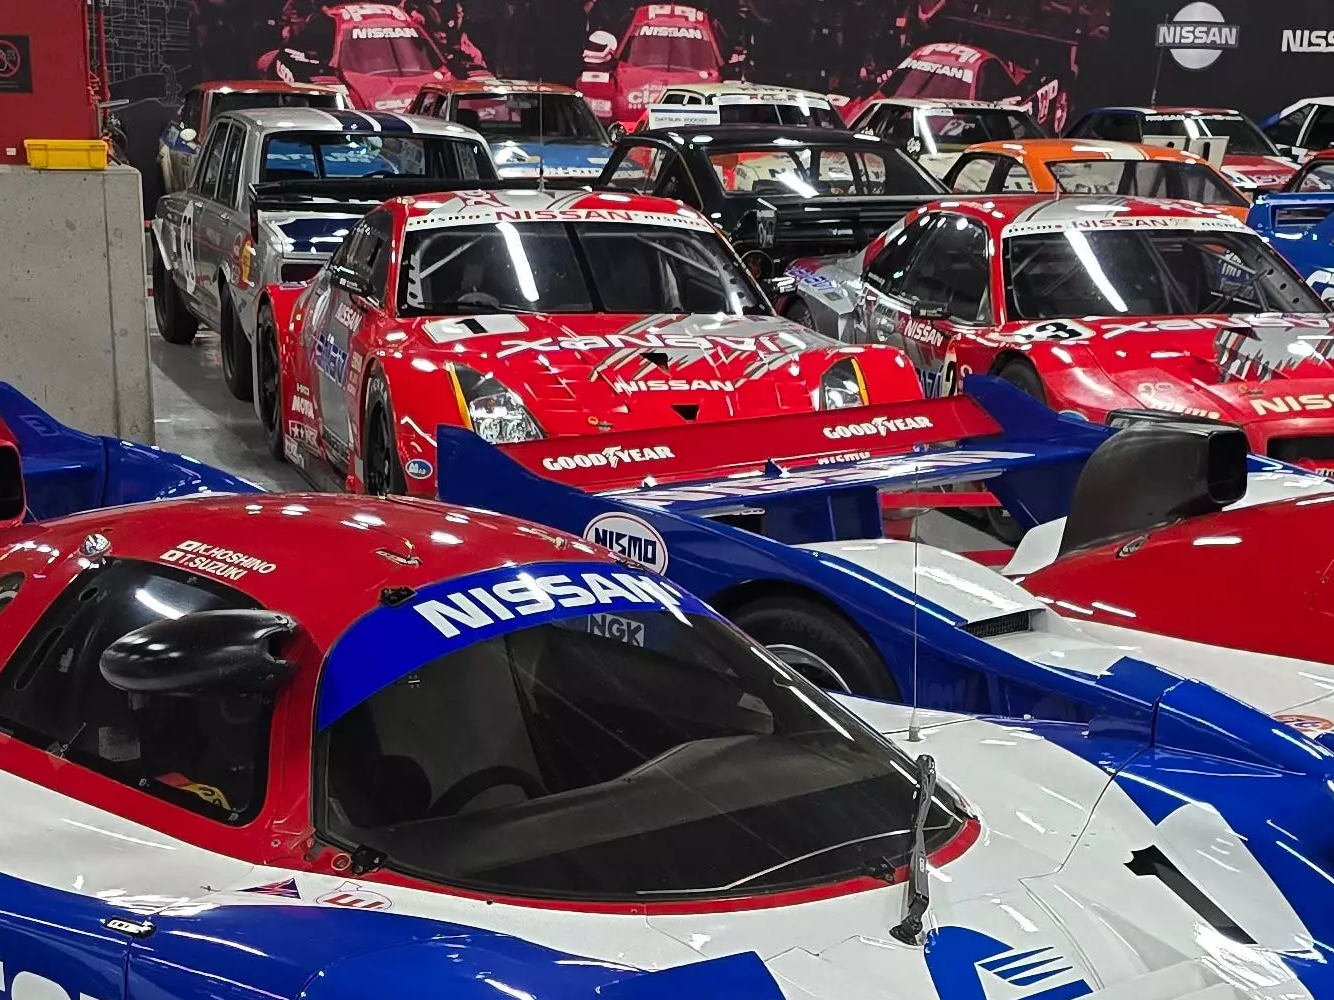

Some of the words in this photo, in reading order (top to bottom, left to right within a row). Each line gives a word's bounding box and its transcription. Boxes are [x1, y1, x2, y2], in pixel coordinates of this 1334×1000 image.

[1158, 26, 1237, 45] NISSAN
[495, 210, 633, 221] NISSAN
[1070, 218, 1168, 229] NISSAN
[903, 317, 945, 348] NISSAN
[613, 380, 736, 396] NISSAN
[822, 416, 934, 440] GOODYEAR
[542, 446, 675, 471] GOODYEAR
[195, 542, 277, 575] K.HOSHINO
[594, 527, 657, 566] NISMO
[182, 556, 249, 581] T.SUZUKI
[412, 572, 680, 638] NISSAN
[588, 614, 645, 648] NGK
[1123, 843, 1259, 945] 1
